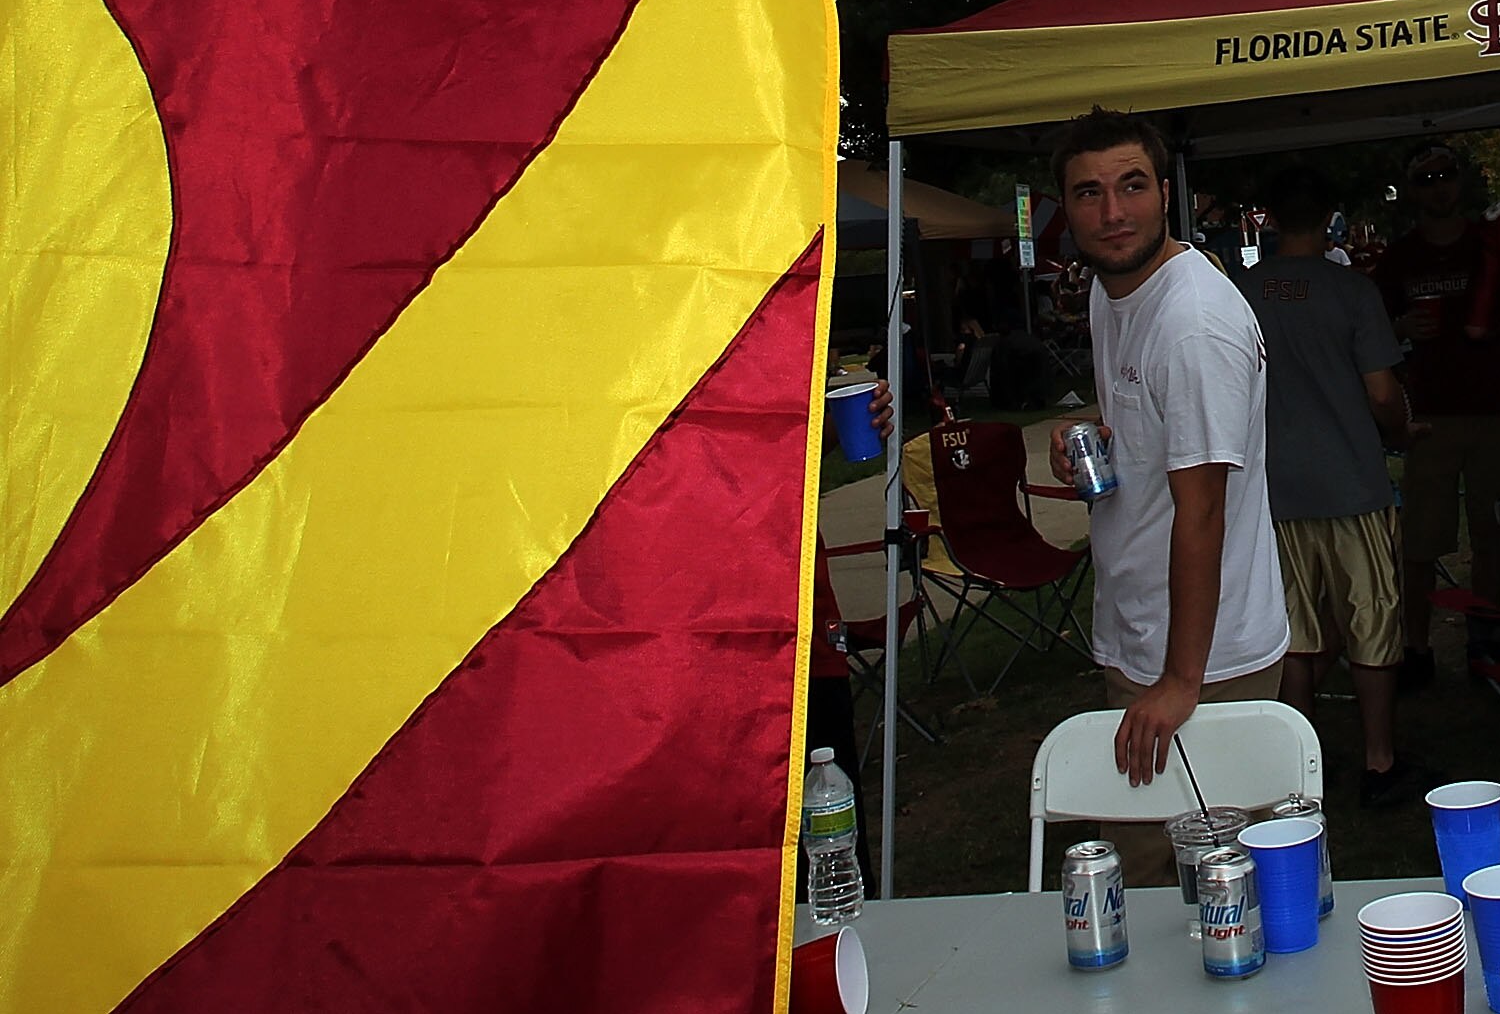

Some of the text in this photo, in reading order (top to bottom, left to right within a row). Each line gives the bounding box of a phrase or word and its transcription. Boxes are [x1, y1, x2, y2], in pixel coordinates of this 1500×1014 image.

[1215, 28, 1347, 66] FLORIDA
[1356, 14, 1450, 51] STATE
[1263, 277, 1311, 301] FSU
[941, 430, 968, 448] FSU
[1207, 924, 1247, 940] Light
